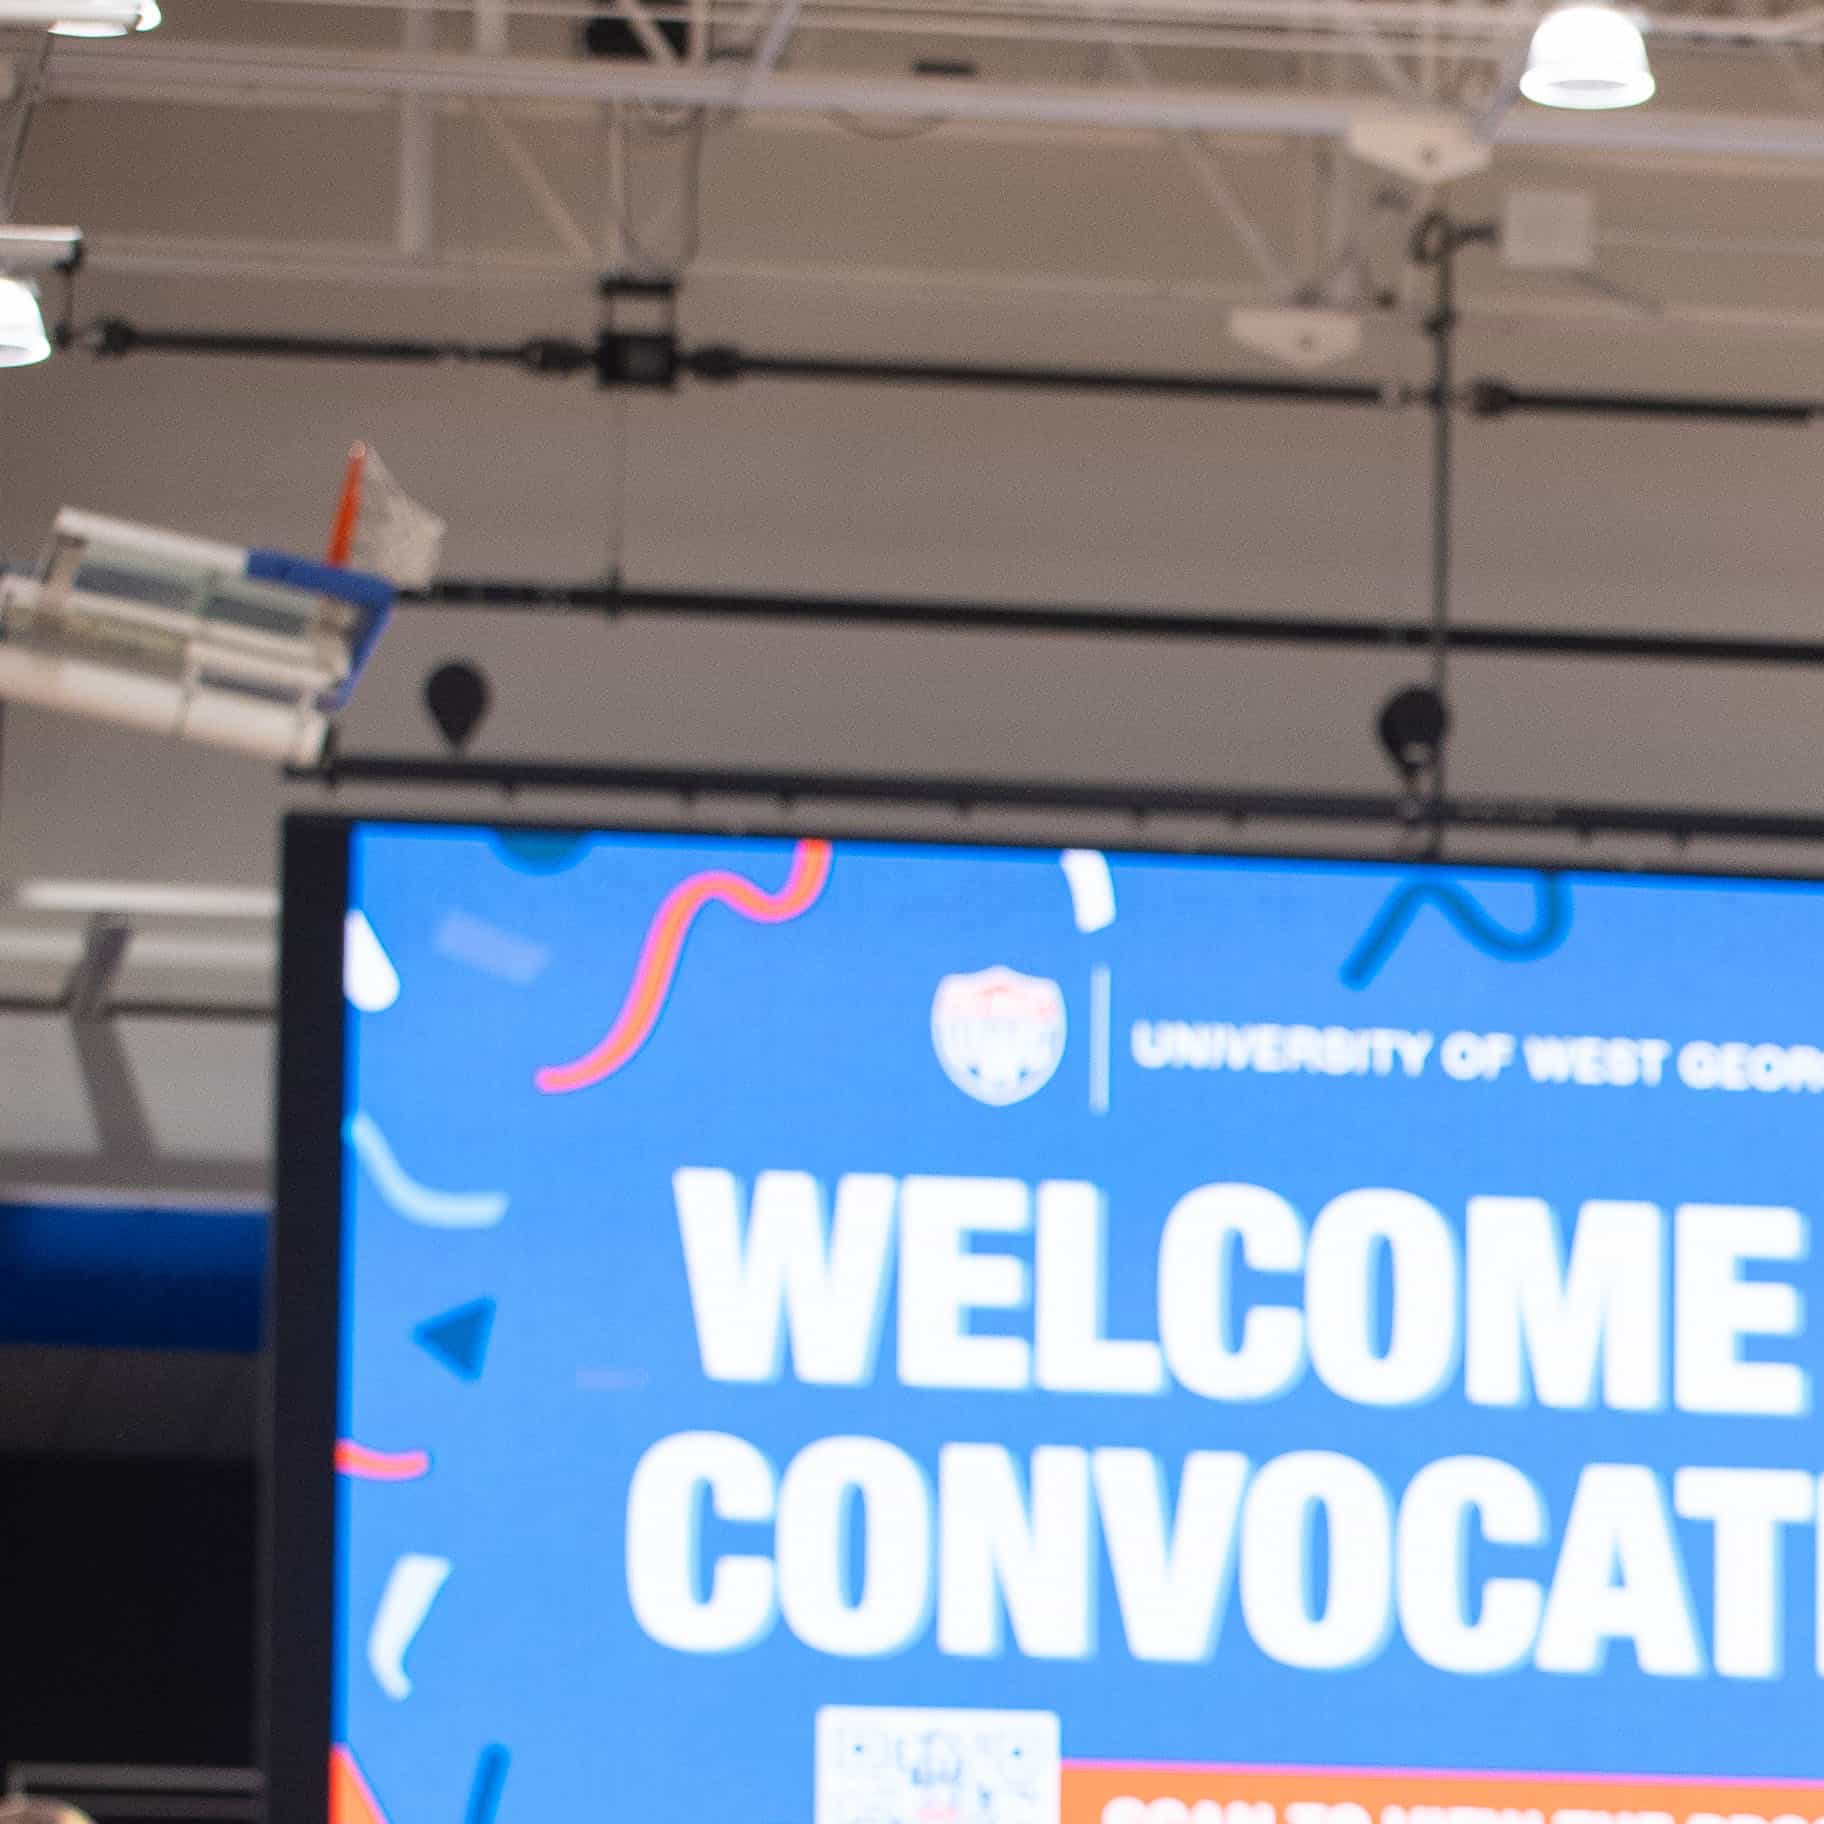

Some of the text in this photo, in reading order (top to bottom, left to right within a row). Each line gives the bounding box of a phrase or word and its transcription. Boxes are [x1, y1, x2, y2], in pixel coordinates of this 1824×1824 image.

[1133, 1020, 1431, 1077] UNIVERSITY
[1441, 1030, 1513, 1081] OF
[1524, 1034, 1669, 1087] WEST
[673, 1167, 1810, 1416] WELCOME
